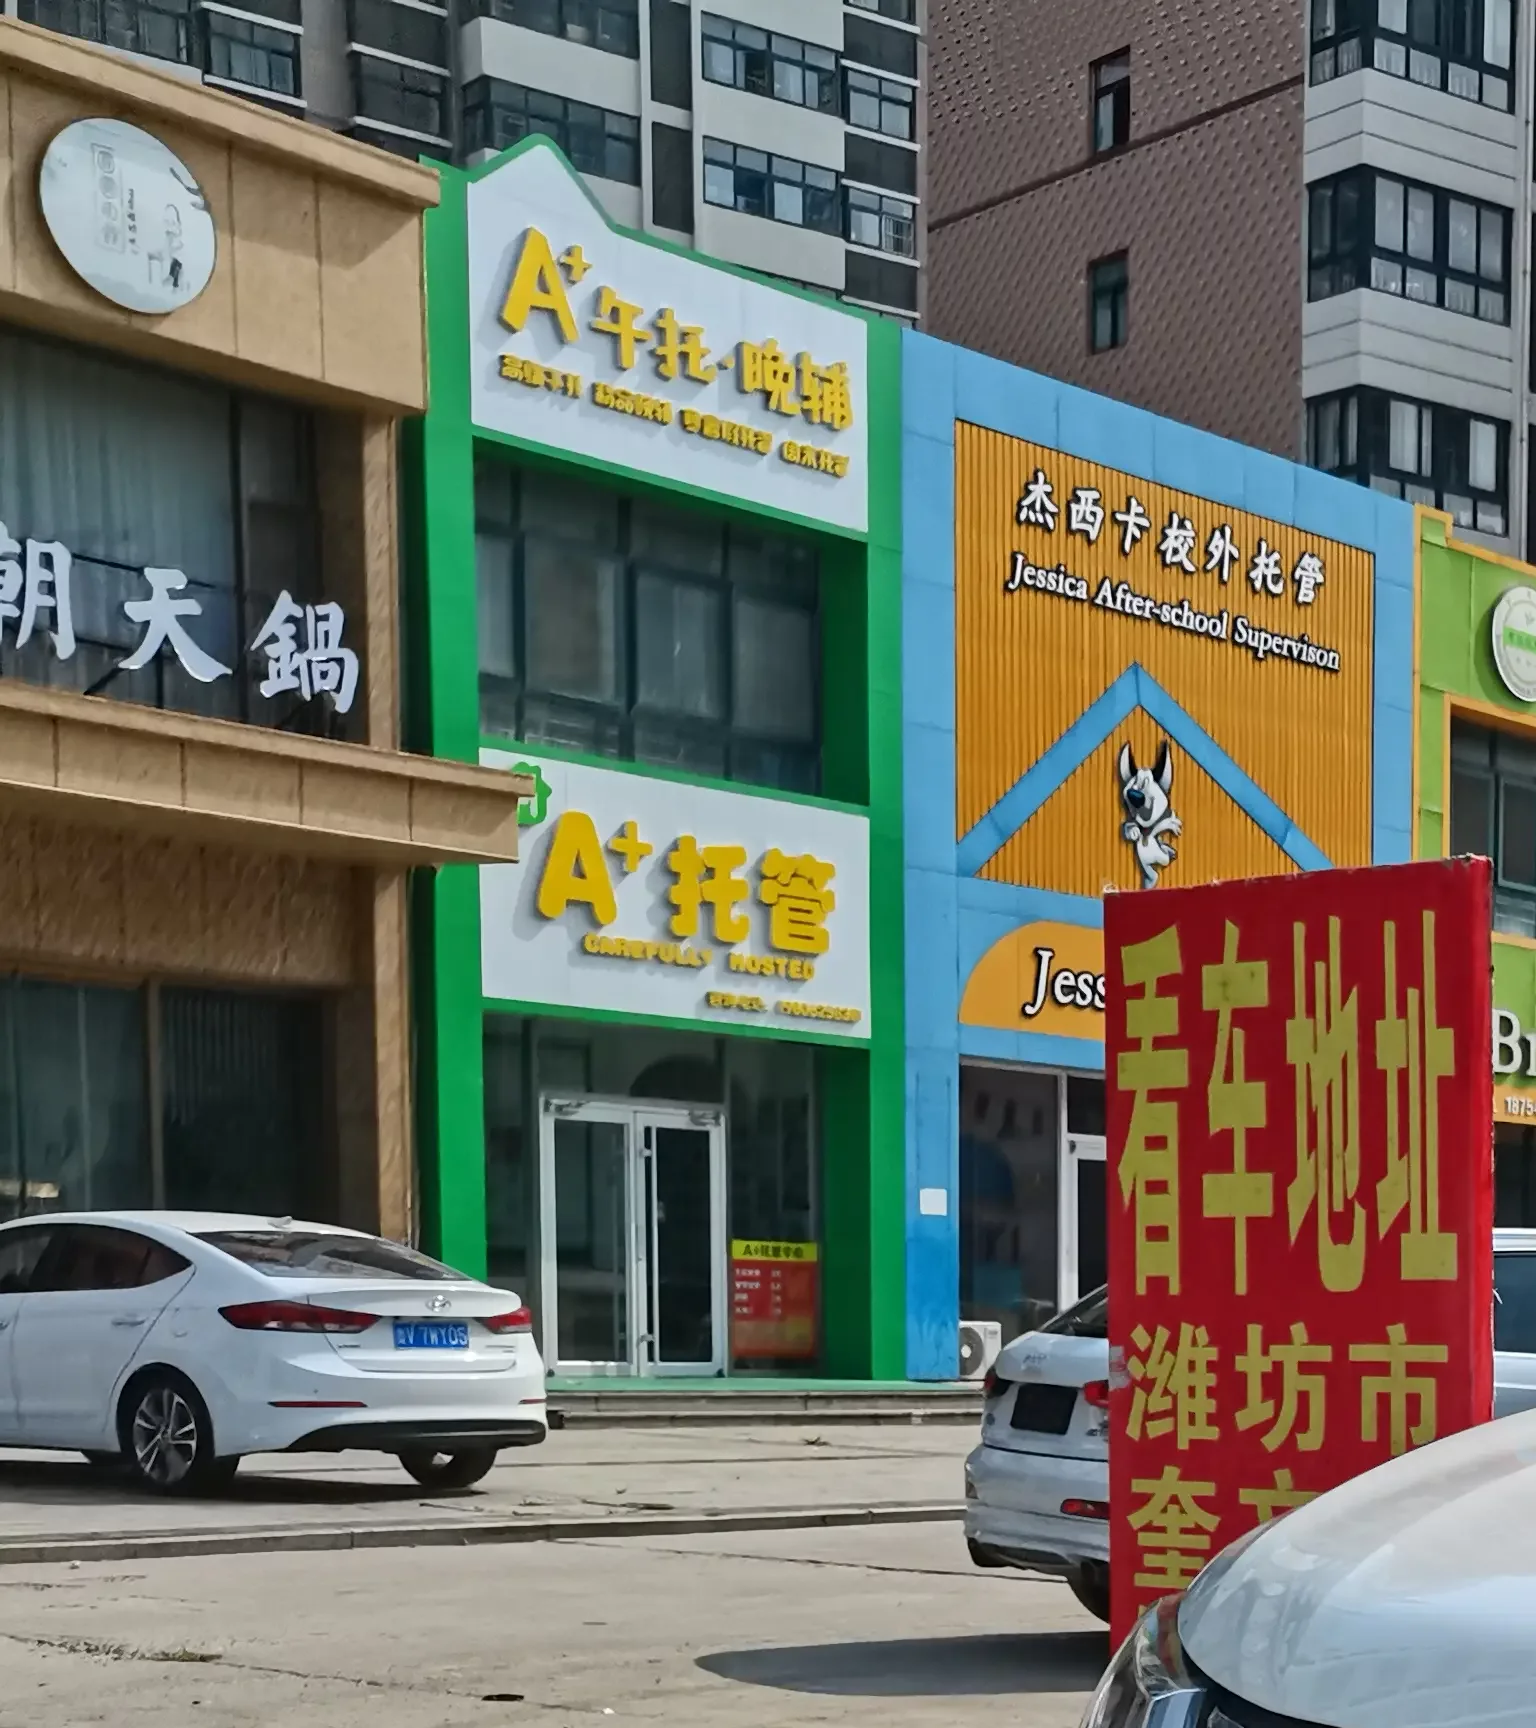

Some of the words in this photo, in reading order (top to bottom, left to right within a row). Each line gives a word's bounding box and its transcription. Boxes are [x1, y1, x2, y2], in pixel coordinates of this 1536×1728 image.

[1008, 553, 1088, 600] Jessica
[1094, 577, 1228, 639] After-school
[1019, 470, 1325, 604] 杰西卡校外托管
[584, 932, 713, 969] CAREFULLY
[729, 952, 816, 982] HOSTED
[1117, 909, 1458, 1297] 看车地址
[1125, 1321, 1450, 1456] 潍坊市
